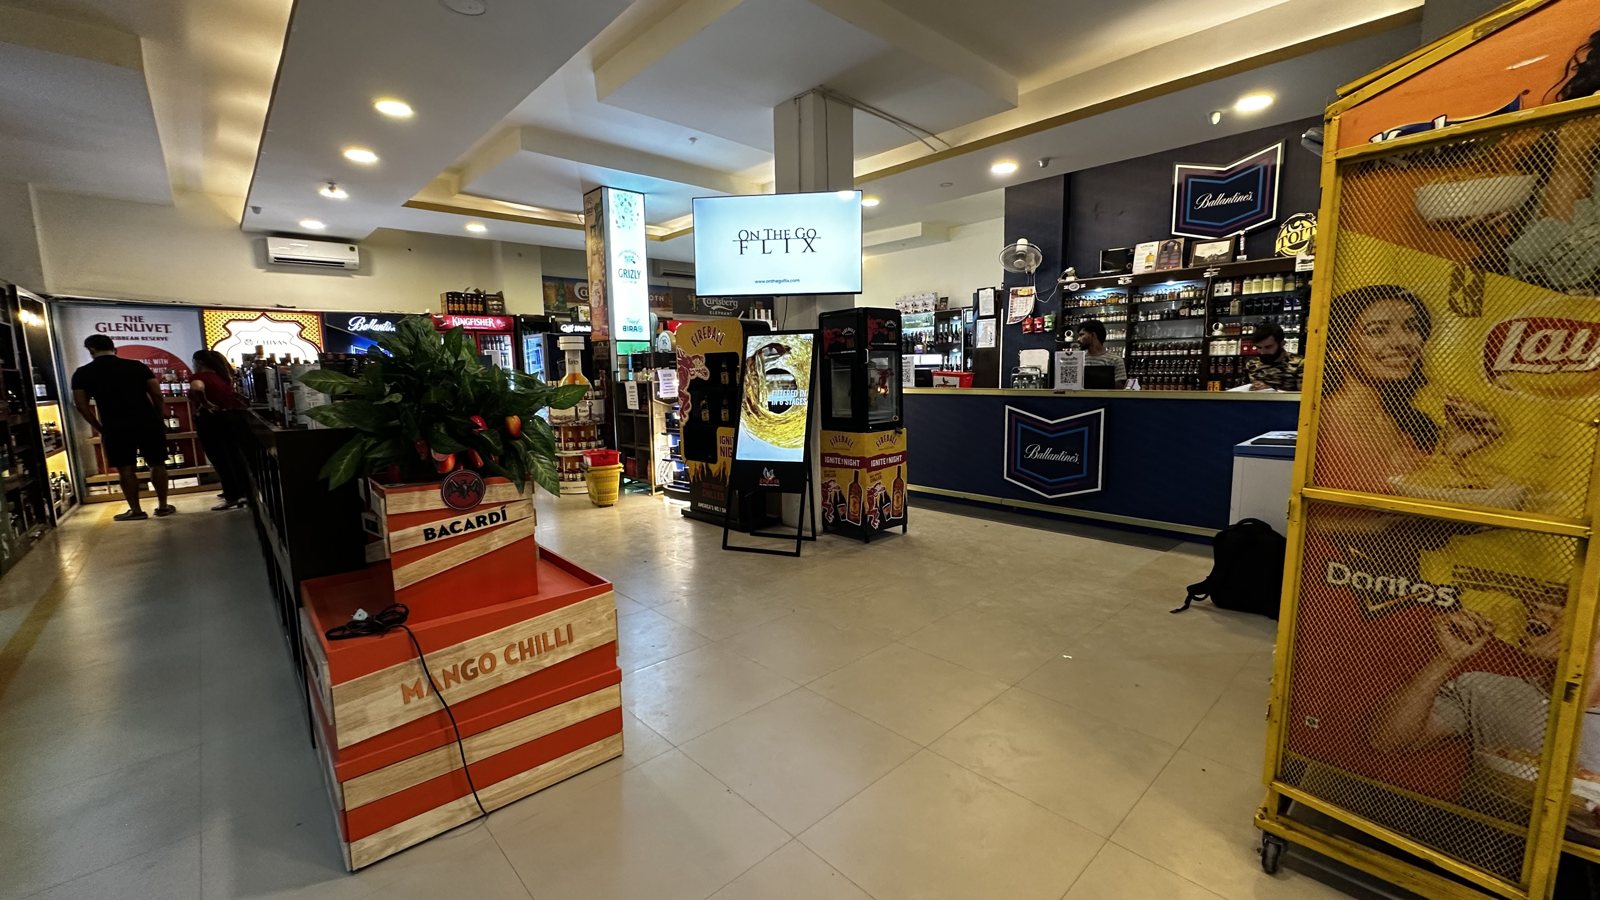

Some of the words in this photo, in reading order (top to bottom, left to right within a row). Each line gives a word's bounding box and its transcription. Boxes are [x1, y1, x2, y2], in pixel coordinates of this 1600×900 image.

[1194, 190, 1253, 209] Ballantine's
[738, 229, 760, 241] ON
[763, 228, 790, 240] THE
[795, 227, 817, 240] GO
[739, 238, 817, 255] FLIX
[121, 314, 145, 322] THE
[452, 316, 496, 328] KINGFISHER
[95, 322, 171, 333] GLENLIVET
[690, 326, 726, 348] FIREBALL
[785, 397, 808, 406] STAGES
[1024, 443, 1079, 463] Ballantine's
[824, 456, 841, 465] IGNITE
[843, 459, 860, 467] NIGHT
[870, 457, 886, 467] IGNITE
[888, 454, 903, 463] NIGHT
[1326, 561, 1456, 608] Doritos
[400, 652, 497, 705] MANGO
[503, 623, 575, 666] CHILLI
